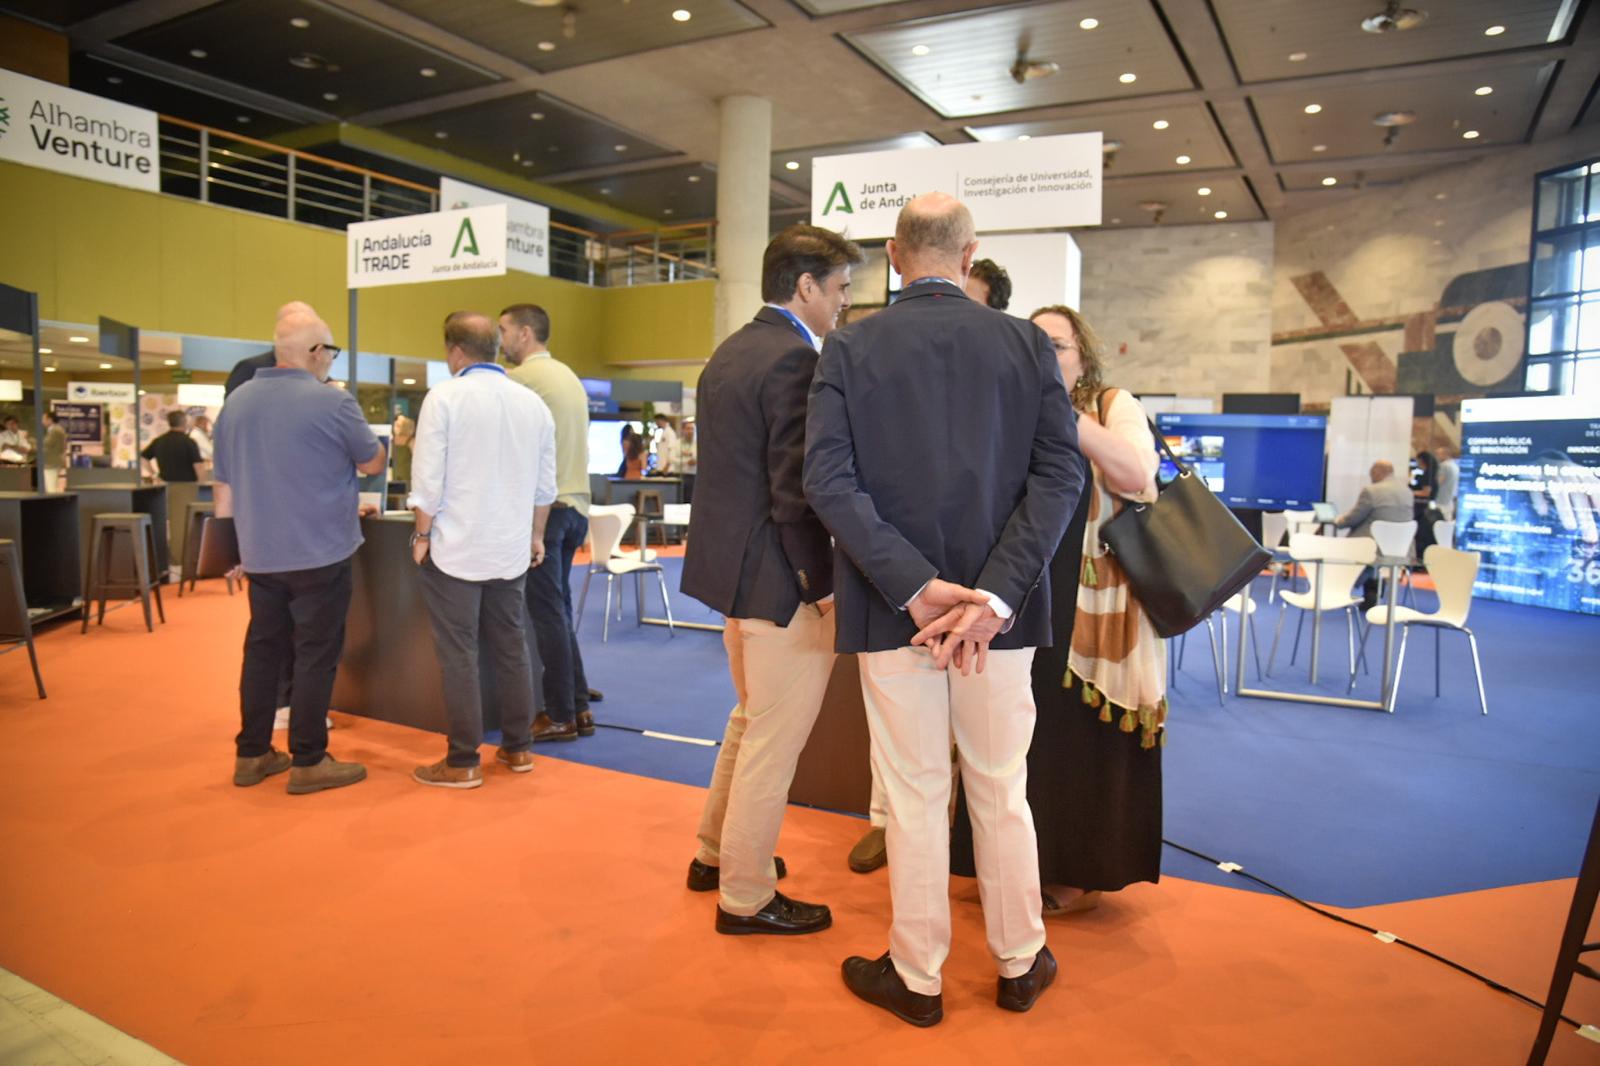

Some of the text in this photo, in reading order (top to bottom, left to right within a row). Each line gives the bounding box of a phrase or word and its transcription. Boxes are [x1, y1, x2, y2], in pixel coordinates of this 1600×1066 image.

[29, 99, 152, 149] Alhambra
[29, 123, 152, 175] Venture
[964, 169, 1093, 187] Consejería de Universidad,
[860, 182, 897, 195] Junta
[964, 184, 1028, 198] Investigación
[1037, 181, 1093, 193] Innovación
[860, 198, 876, 210] de
[362, 229, 432, 253] Andalucía
[362, 253, 411, 273] TRADE
[432, 264, 451, 273] Junta
[463, 258, 498, 270] Andalucía
[1499, 435, 1532, 446] PÚBLICA
